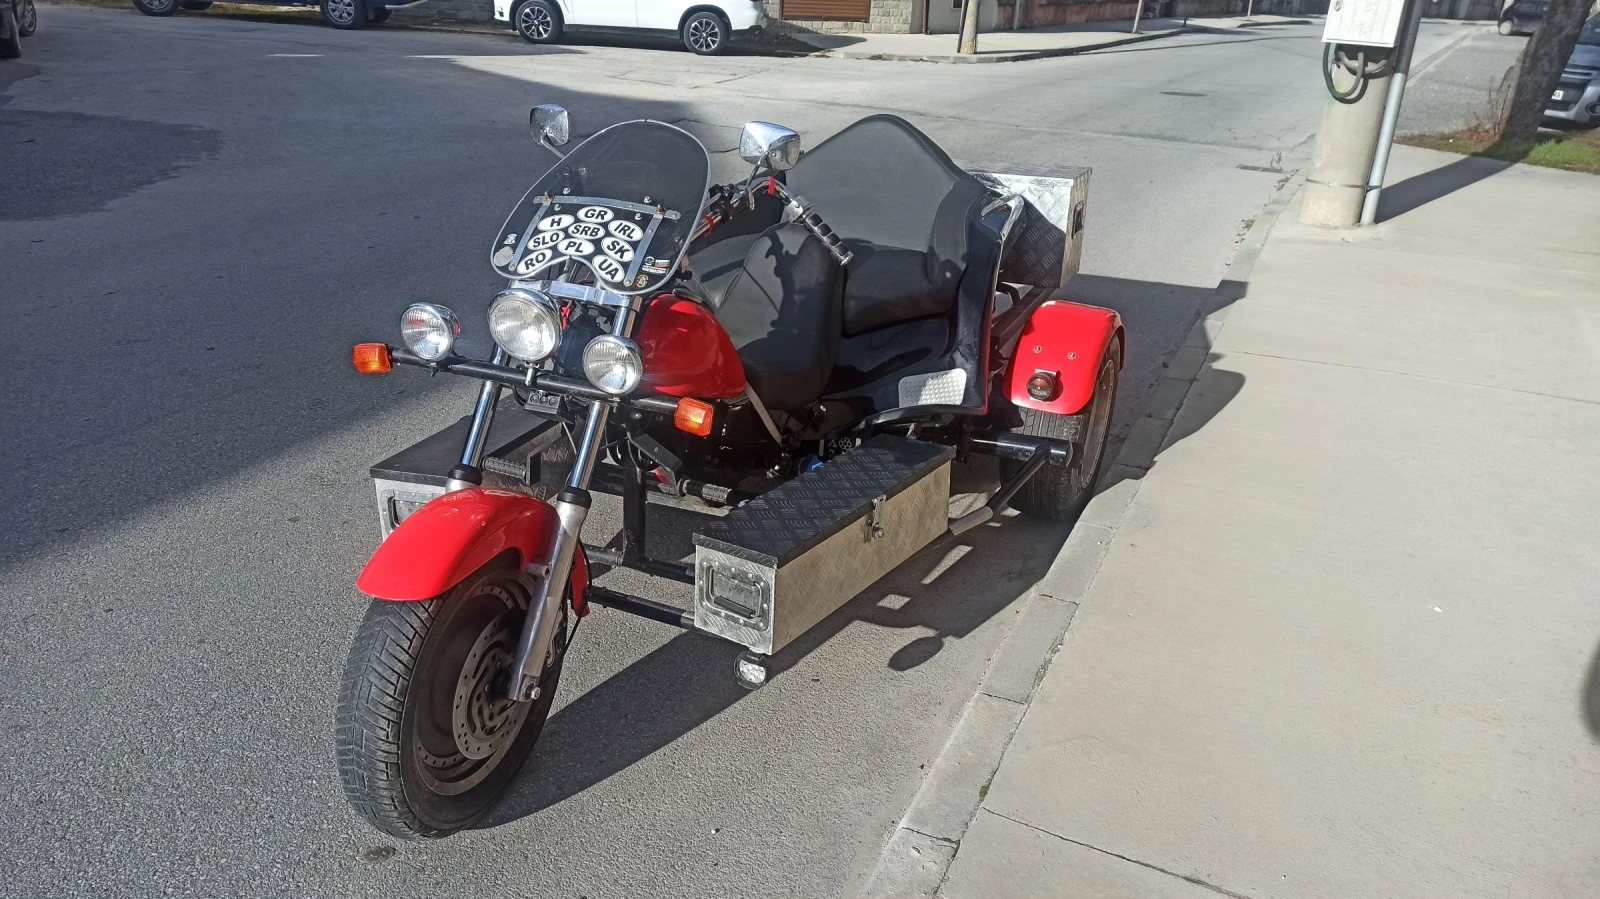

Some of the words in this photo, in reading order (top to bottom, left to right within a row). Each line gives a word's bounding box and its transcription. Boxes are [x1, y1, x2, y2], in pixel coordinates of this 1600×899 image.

[550, 217, 562, 227] H
[584, 208, 608, 220] GR
[571, 224, 600, 237] SRB
[614, 222, 635, 239] IRL
[532, 232, 559, 248] SLO
[564, 241, 584, 253] PL
[606, 240, 630, 259] SK
[524, 252, 546, 270] RO
[598, 258, 619, 280] UA
